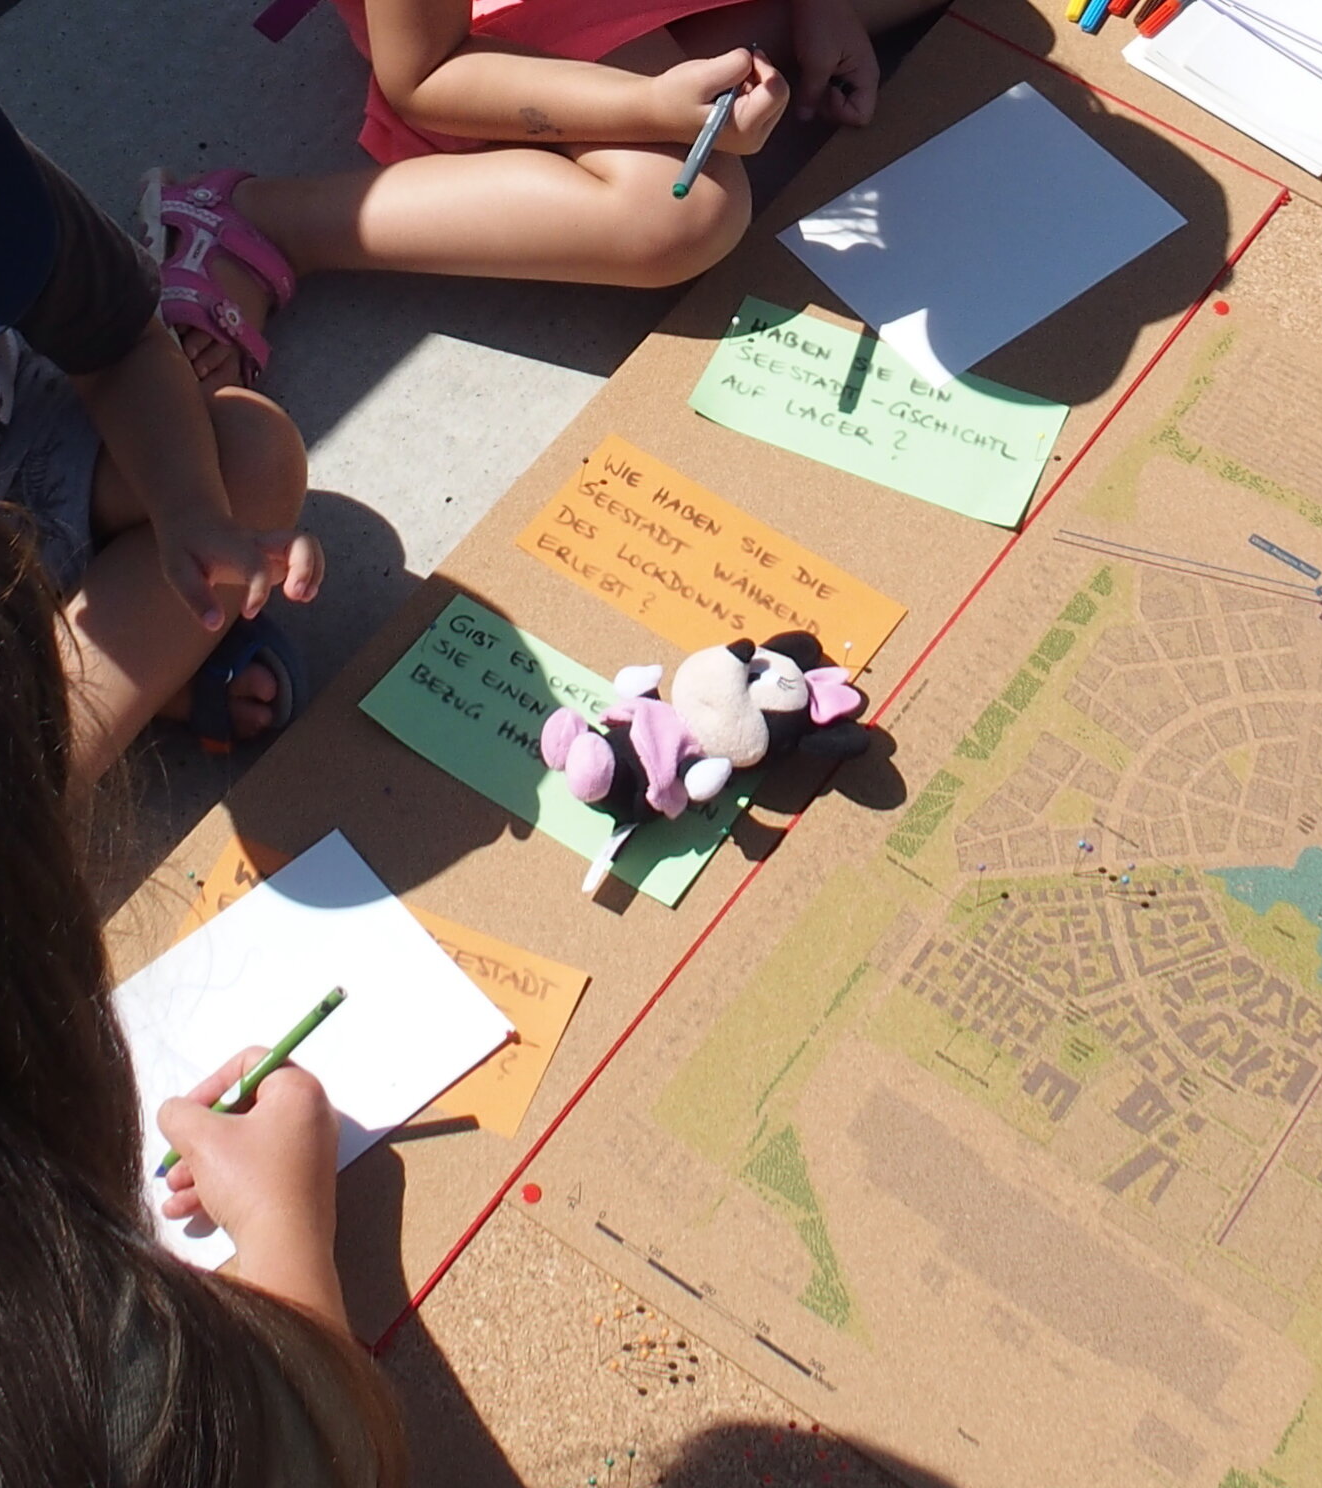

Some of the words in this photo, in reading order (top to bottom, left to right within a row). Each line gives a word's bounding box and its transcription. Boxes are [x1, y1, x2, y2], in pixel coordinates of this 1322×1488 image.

[750, 317, 832, 361] HABEN
[853, 354, 893, 382] SIE
[910, 379, 953, 404] EIN
[721, 373, 767, 400] AUF
[785, 399, 874, 447] LAGER
[581, 480, 691, 556] SEESTADT
[603, 454, 643, 489] WIE
[652, 487, 724, 538] HABEN
[741, 535, 783, 570] SIE
[792, 567, 842, 603] DIE
[536, 532, 633, 598] ERLEBT
[554, 504, 597, 541] DES
[616, 542, 747, 632] LOCKDOWNS
[433, 637, 469, 670] SIE
[480, 670, 548, 717] EINEN
[448, 614, 501, 651] GIBT
[509, 649, 538, 675] ES
[408, 663, 483, 723] BEZUG
[497, 718, 544, 762] HAB
